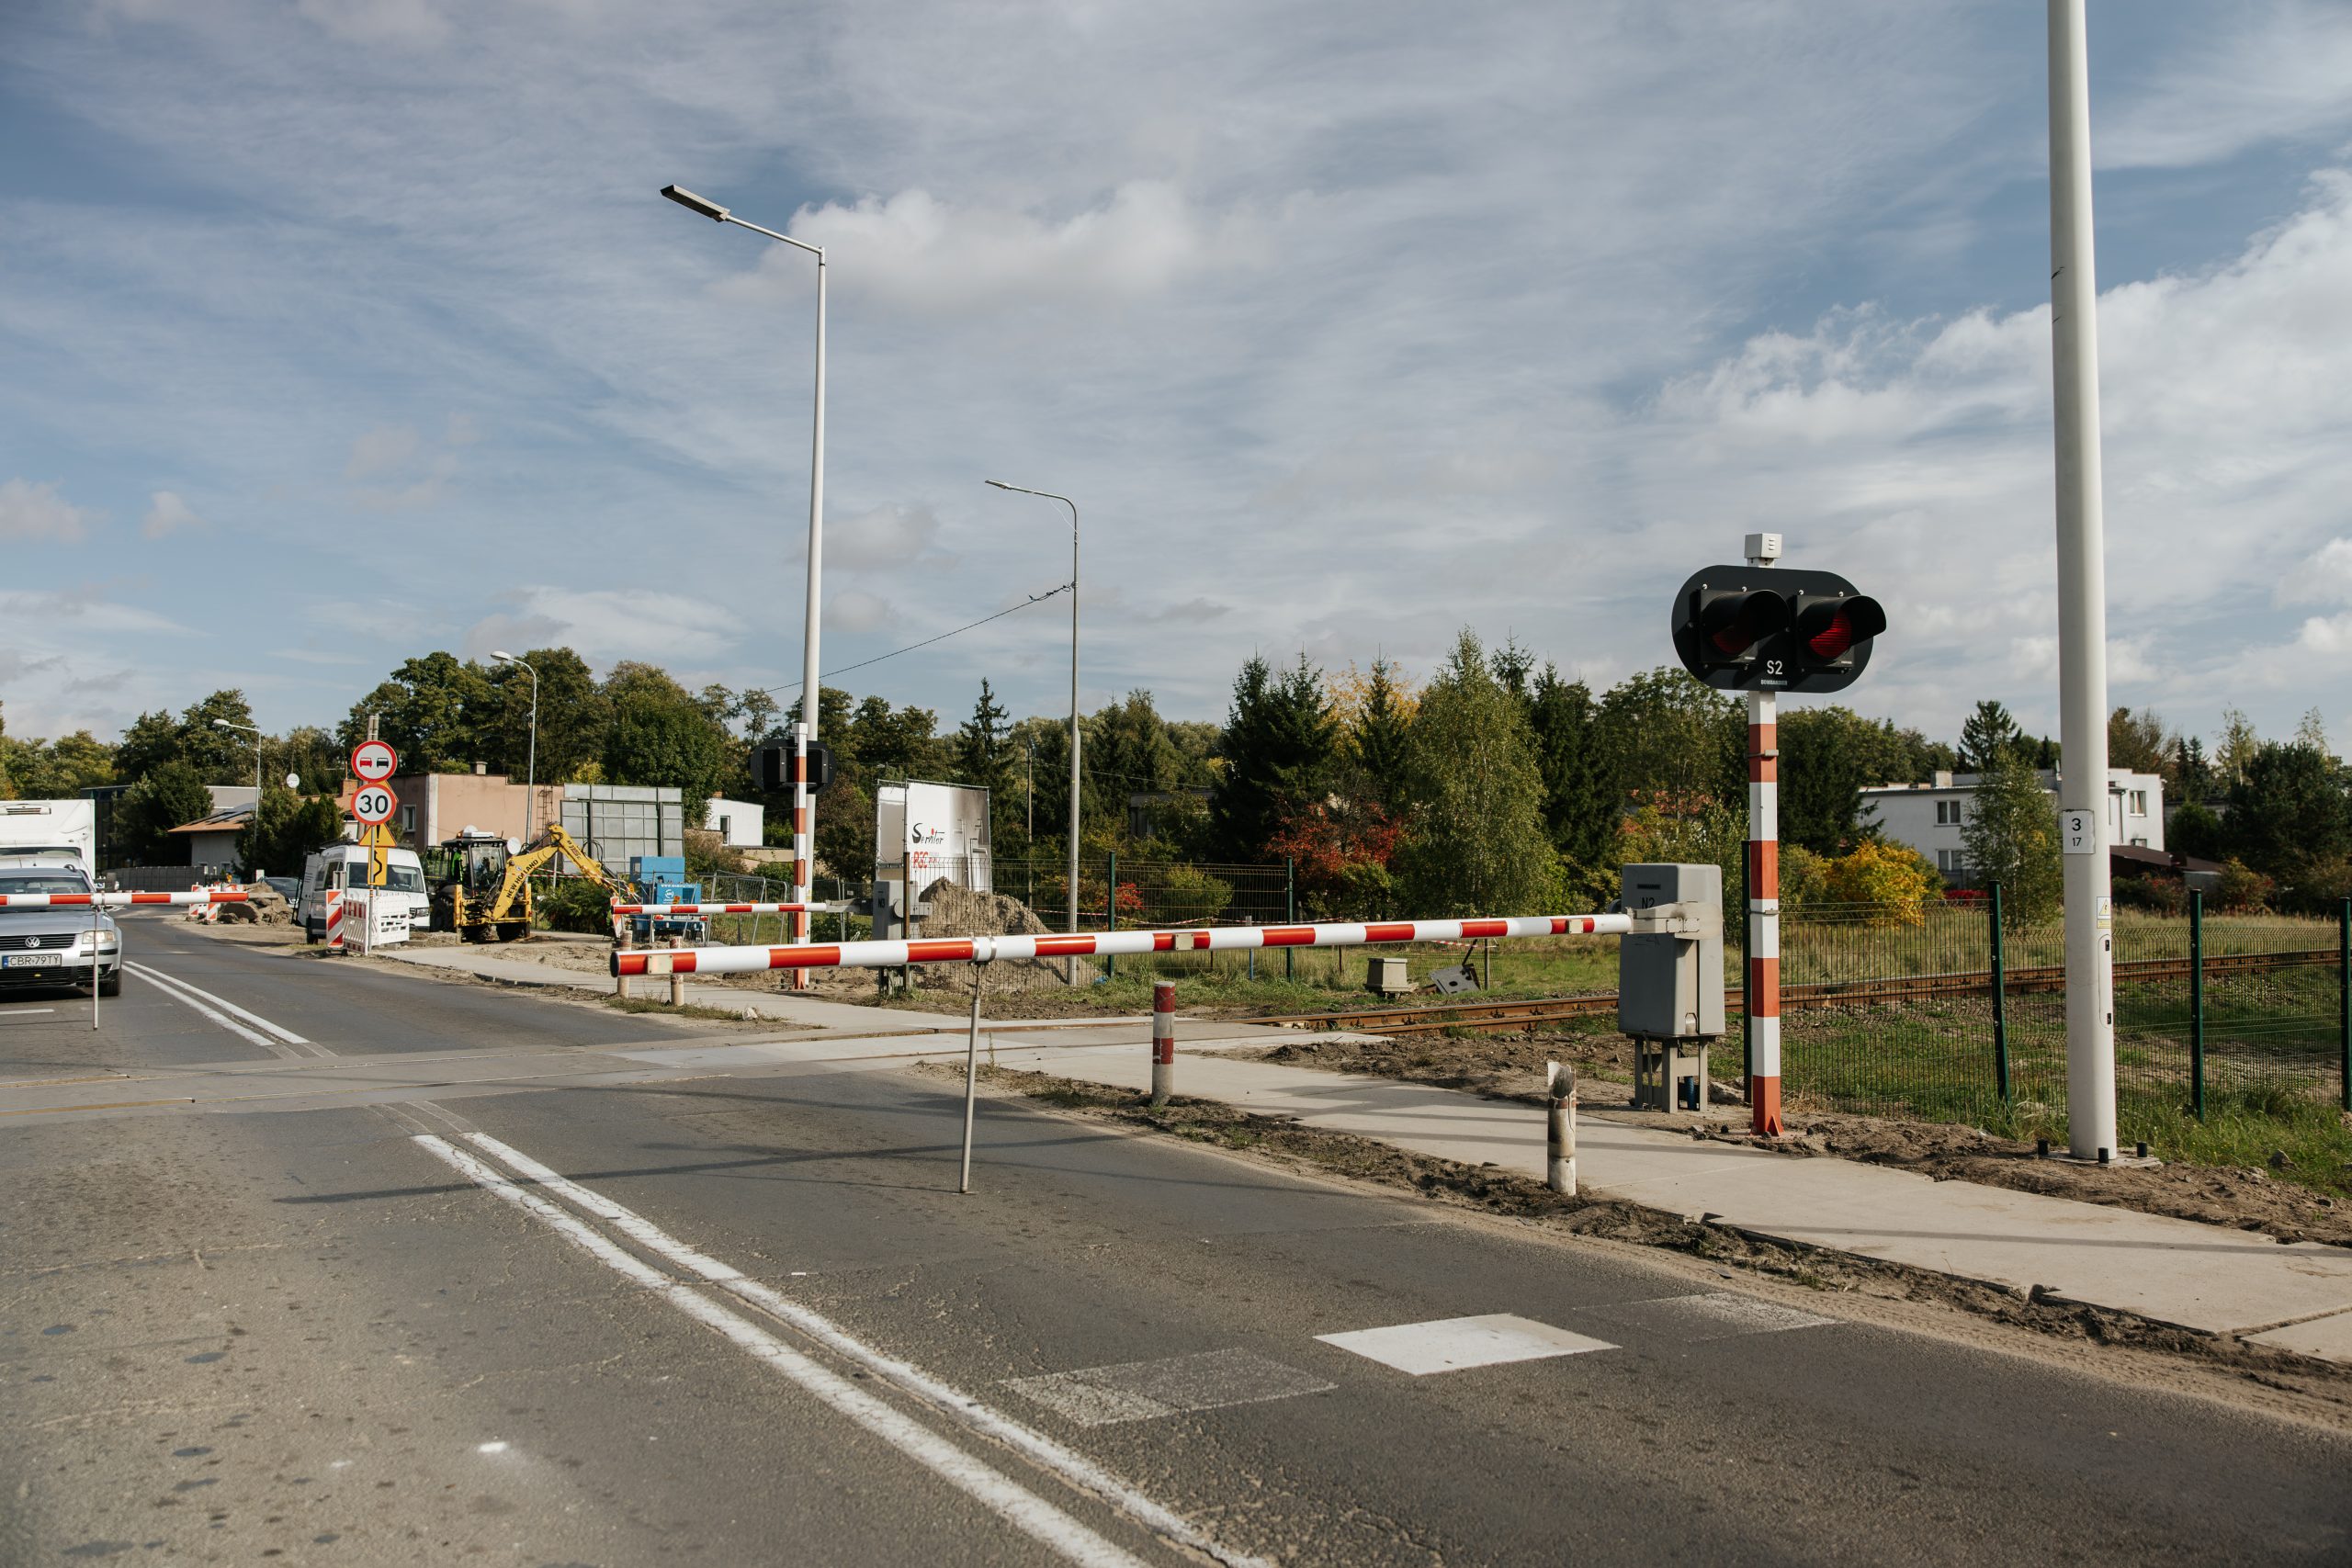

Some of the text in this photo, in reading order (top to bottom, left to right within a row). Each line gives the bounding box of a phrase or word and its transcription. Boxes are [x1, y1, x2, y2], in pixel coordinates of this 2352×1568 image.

[1767, 660, 1783, 675] S2
[358, 795, 389, 814] 30
[2072, 818, 2082, 831] 3
[2072, 837, 2082, 847] 17
[506, 883, 517, 898] NEW
[1641, 897, 1656, 909] N2
[10, 955, 60, 966] CBR 79TY
